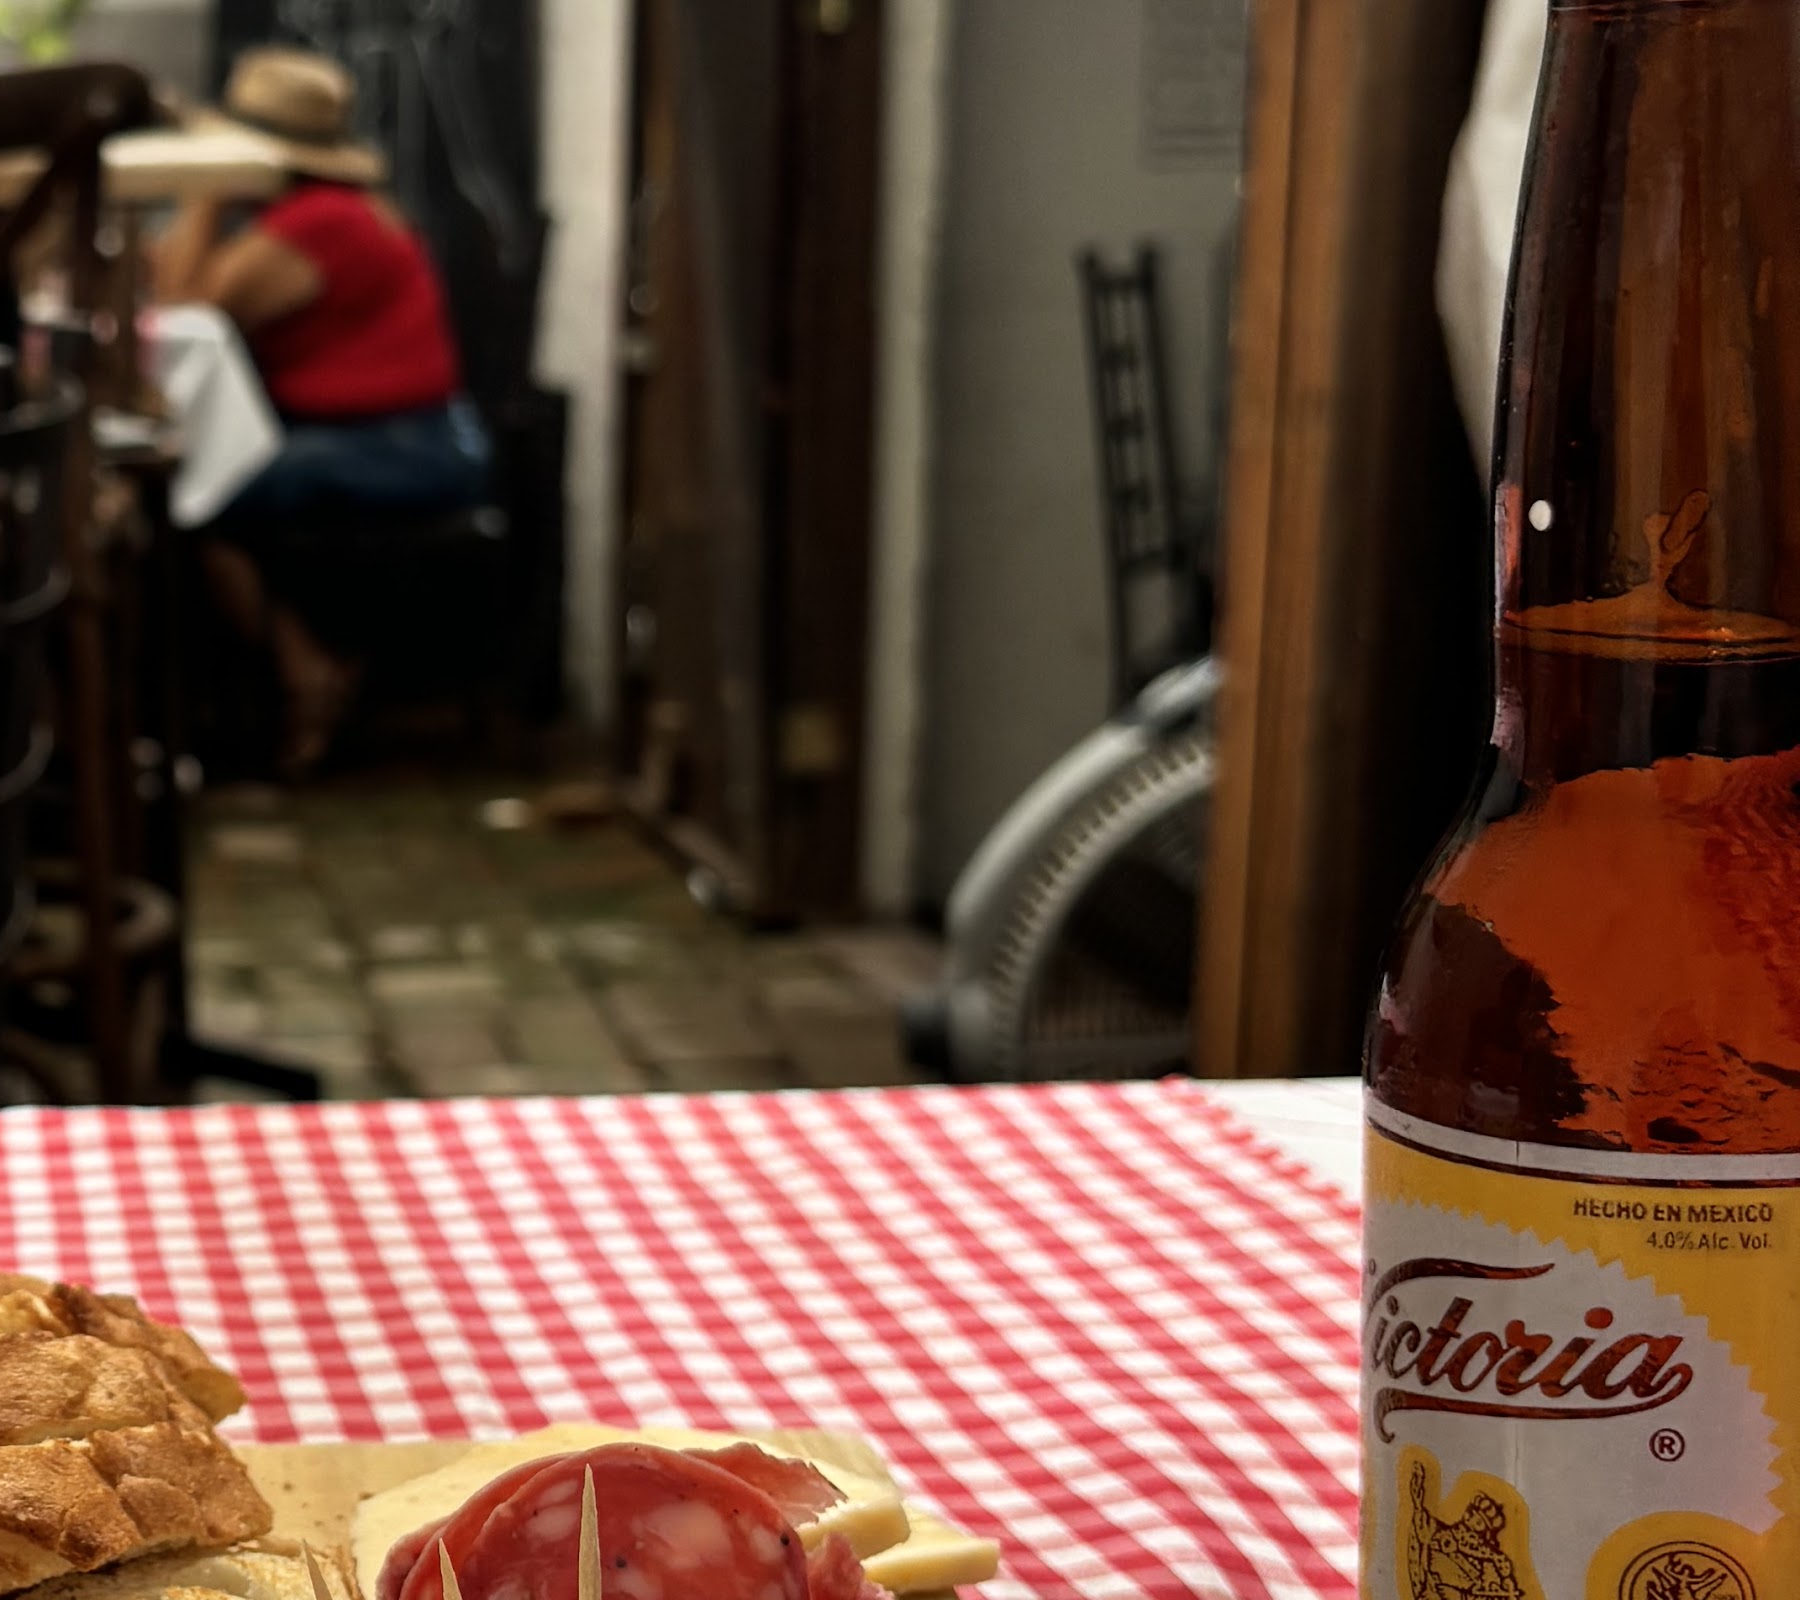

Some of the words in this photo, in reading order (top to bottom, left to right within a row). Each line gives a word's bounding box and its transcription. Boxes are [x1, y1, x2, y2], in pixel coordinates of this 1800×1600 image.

[1573, 1199, 1647, 1221] HECHO
[1653, 1203, 1681, 1222] EN
[1688, 1202, 1774, 1223] MEXICO
[1647, 1231, 1694, 1250] 4.0%
[1367, 1258, 1694, 1419] ictoria
